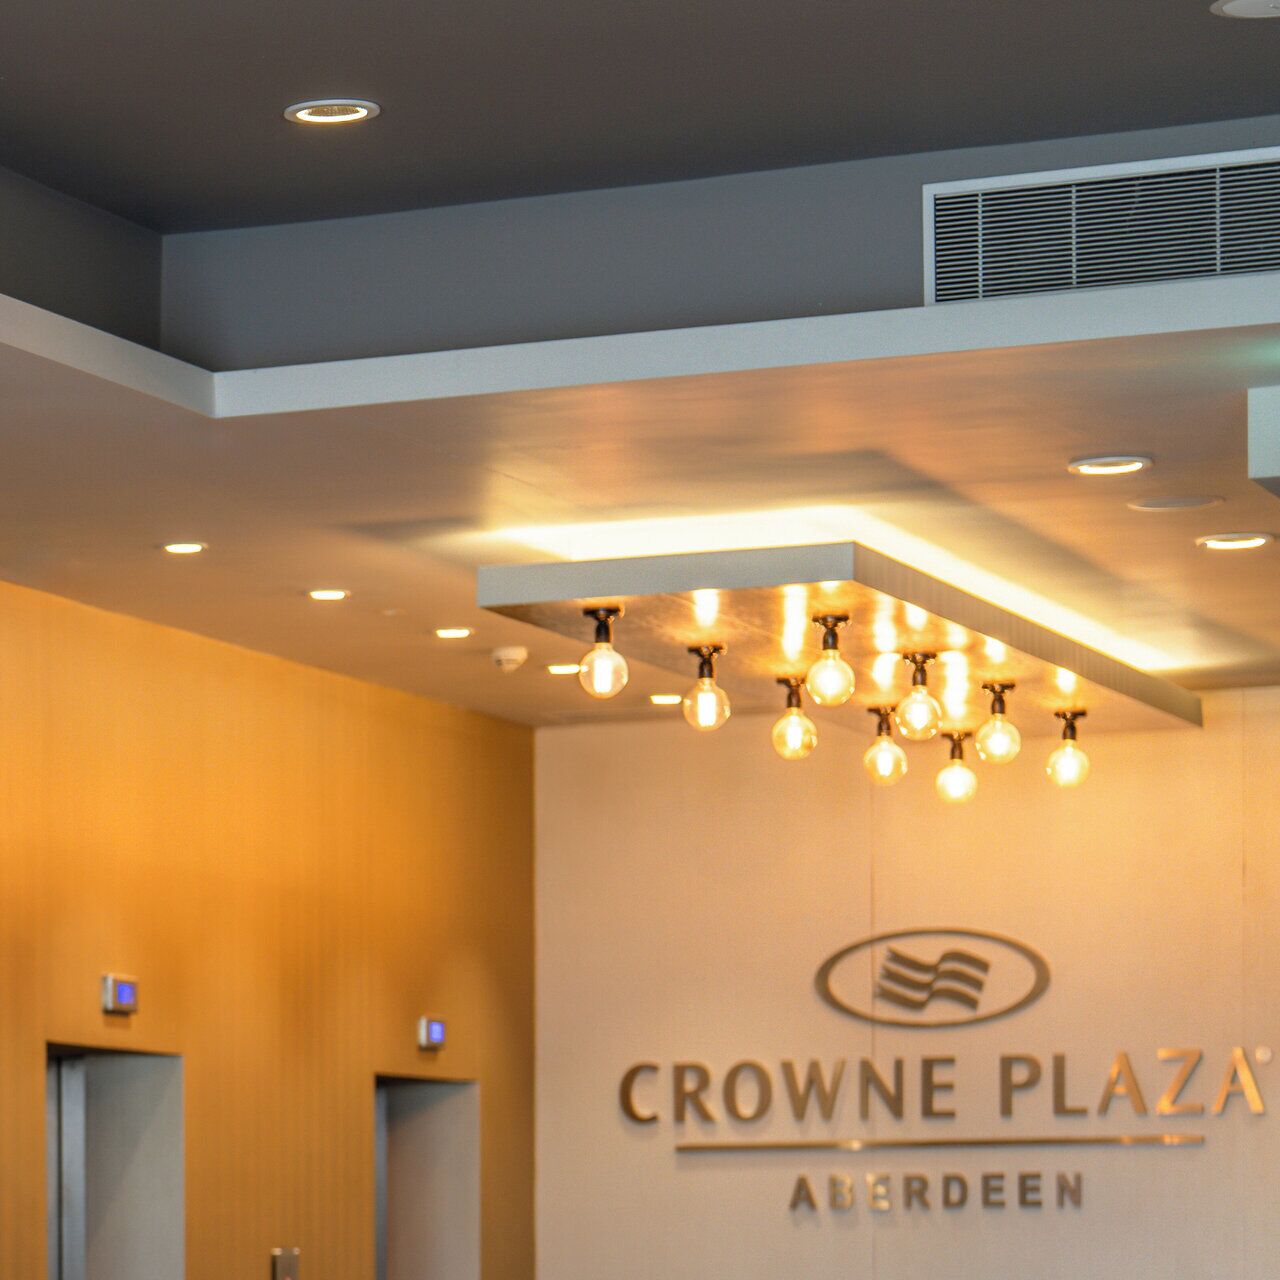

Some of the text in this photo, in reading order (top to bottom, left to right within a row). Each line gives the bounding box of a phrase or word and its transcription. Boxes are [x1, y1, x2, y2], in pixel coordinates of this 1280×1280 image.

[618, 1046, 1265, 1124] CROWNE PLAZA
[789, 1171, 1083, 1212] ABERDEEN
